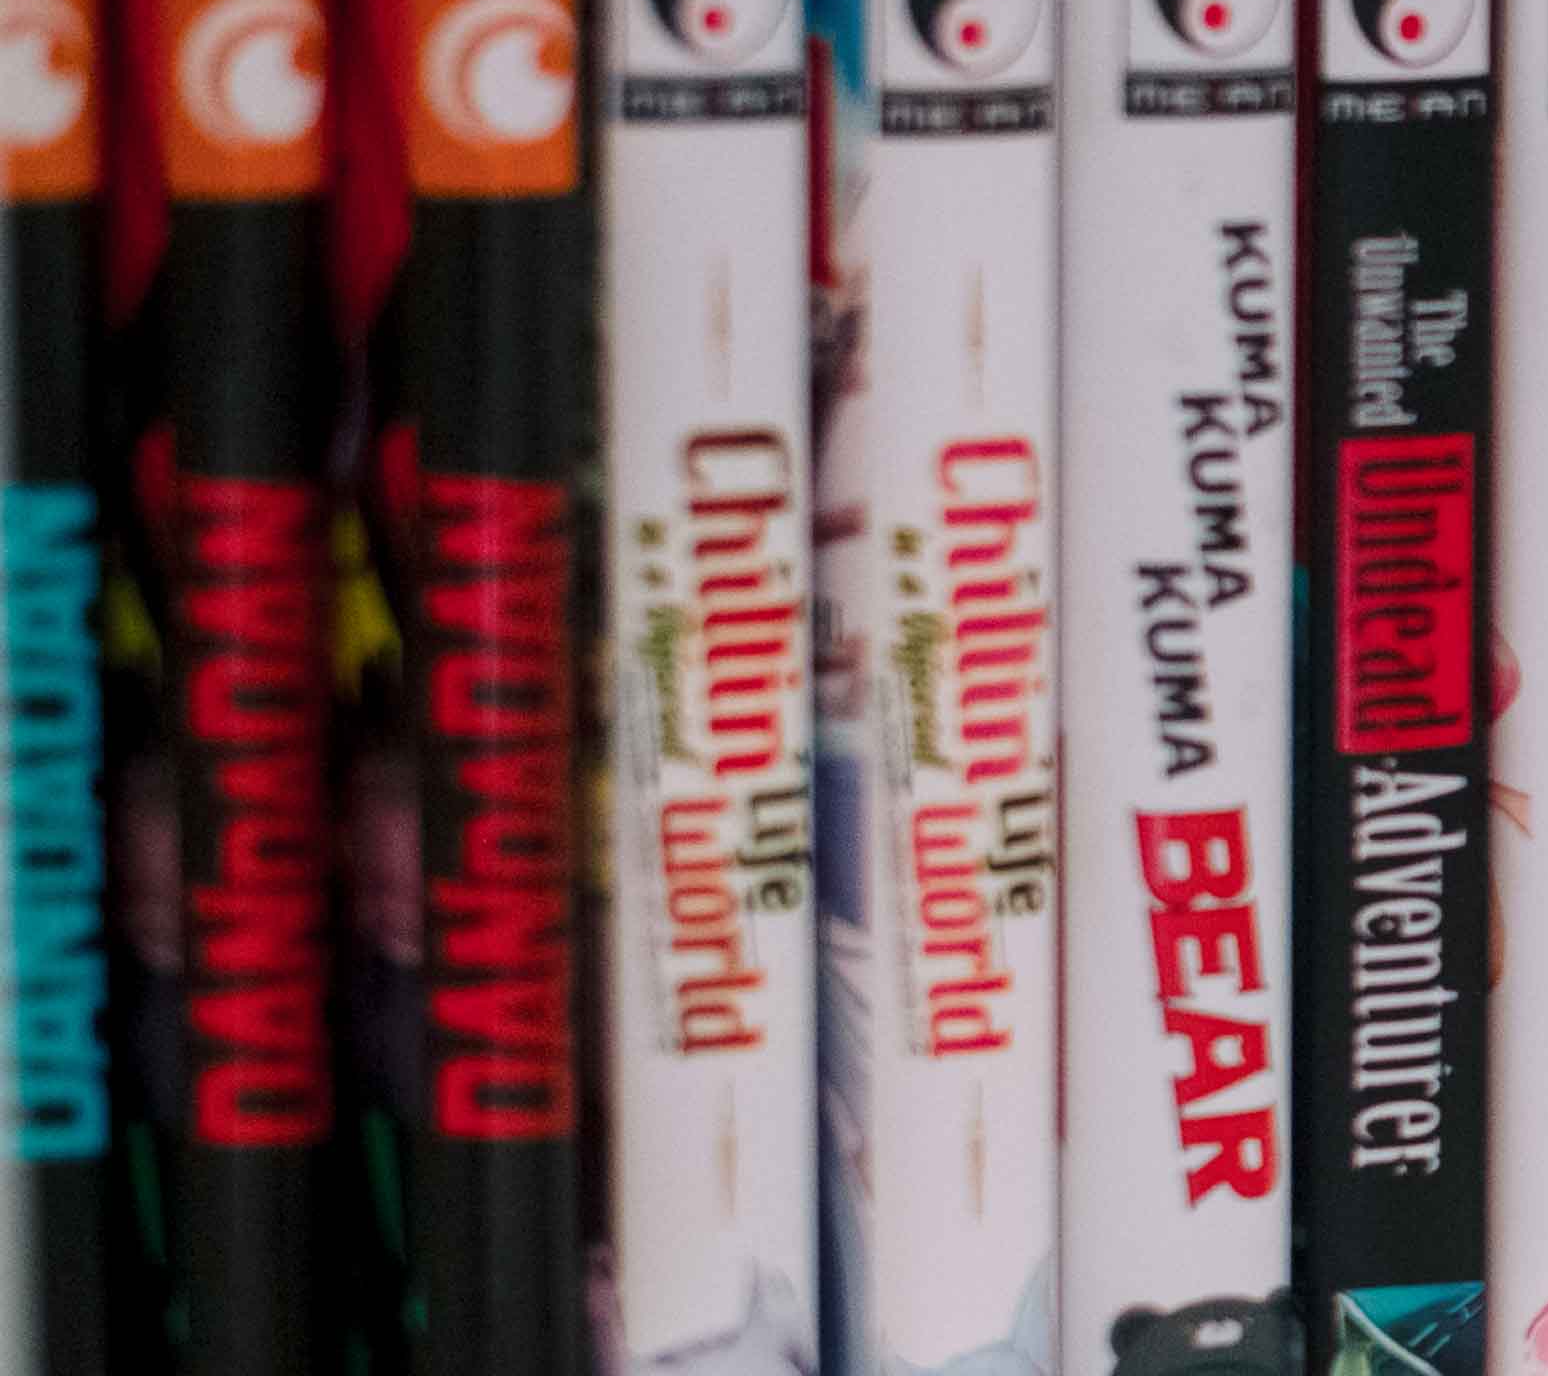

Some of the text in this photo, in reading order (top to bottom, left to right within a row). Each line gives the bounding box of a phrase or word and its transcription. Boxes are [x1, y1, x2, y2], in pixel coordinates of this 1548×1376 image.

[1219, 220, 1282, 441] KUMA
[1409, 288, 1470, 367] The
[1178, 391, 1254, 611] KUMA
[1355, 451, 1464, 736] Undead
[1133, 561, 1218, 780] KUMA
[179, 472, 332, 1148] DANDADAN
[420, 472, 574, 1142] DANDADAN
[986, 784, 1056, 916] Life
[1132, 802, 1278, 1210] BEAR
[1350, 756, 1470, 1176] Adventurer
